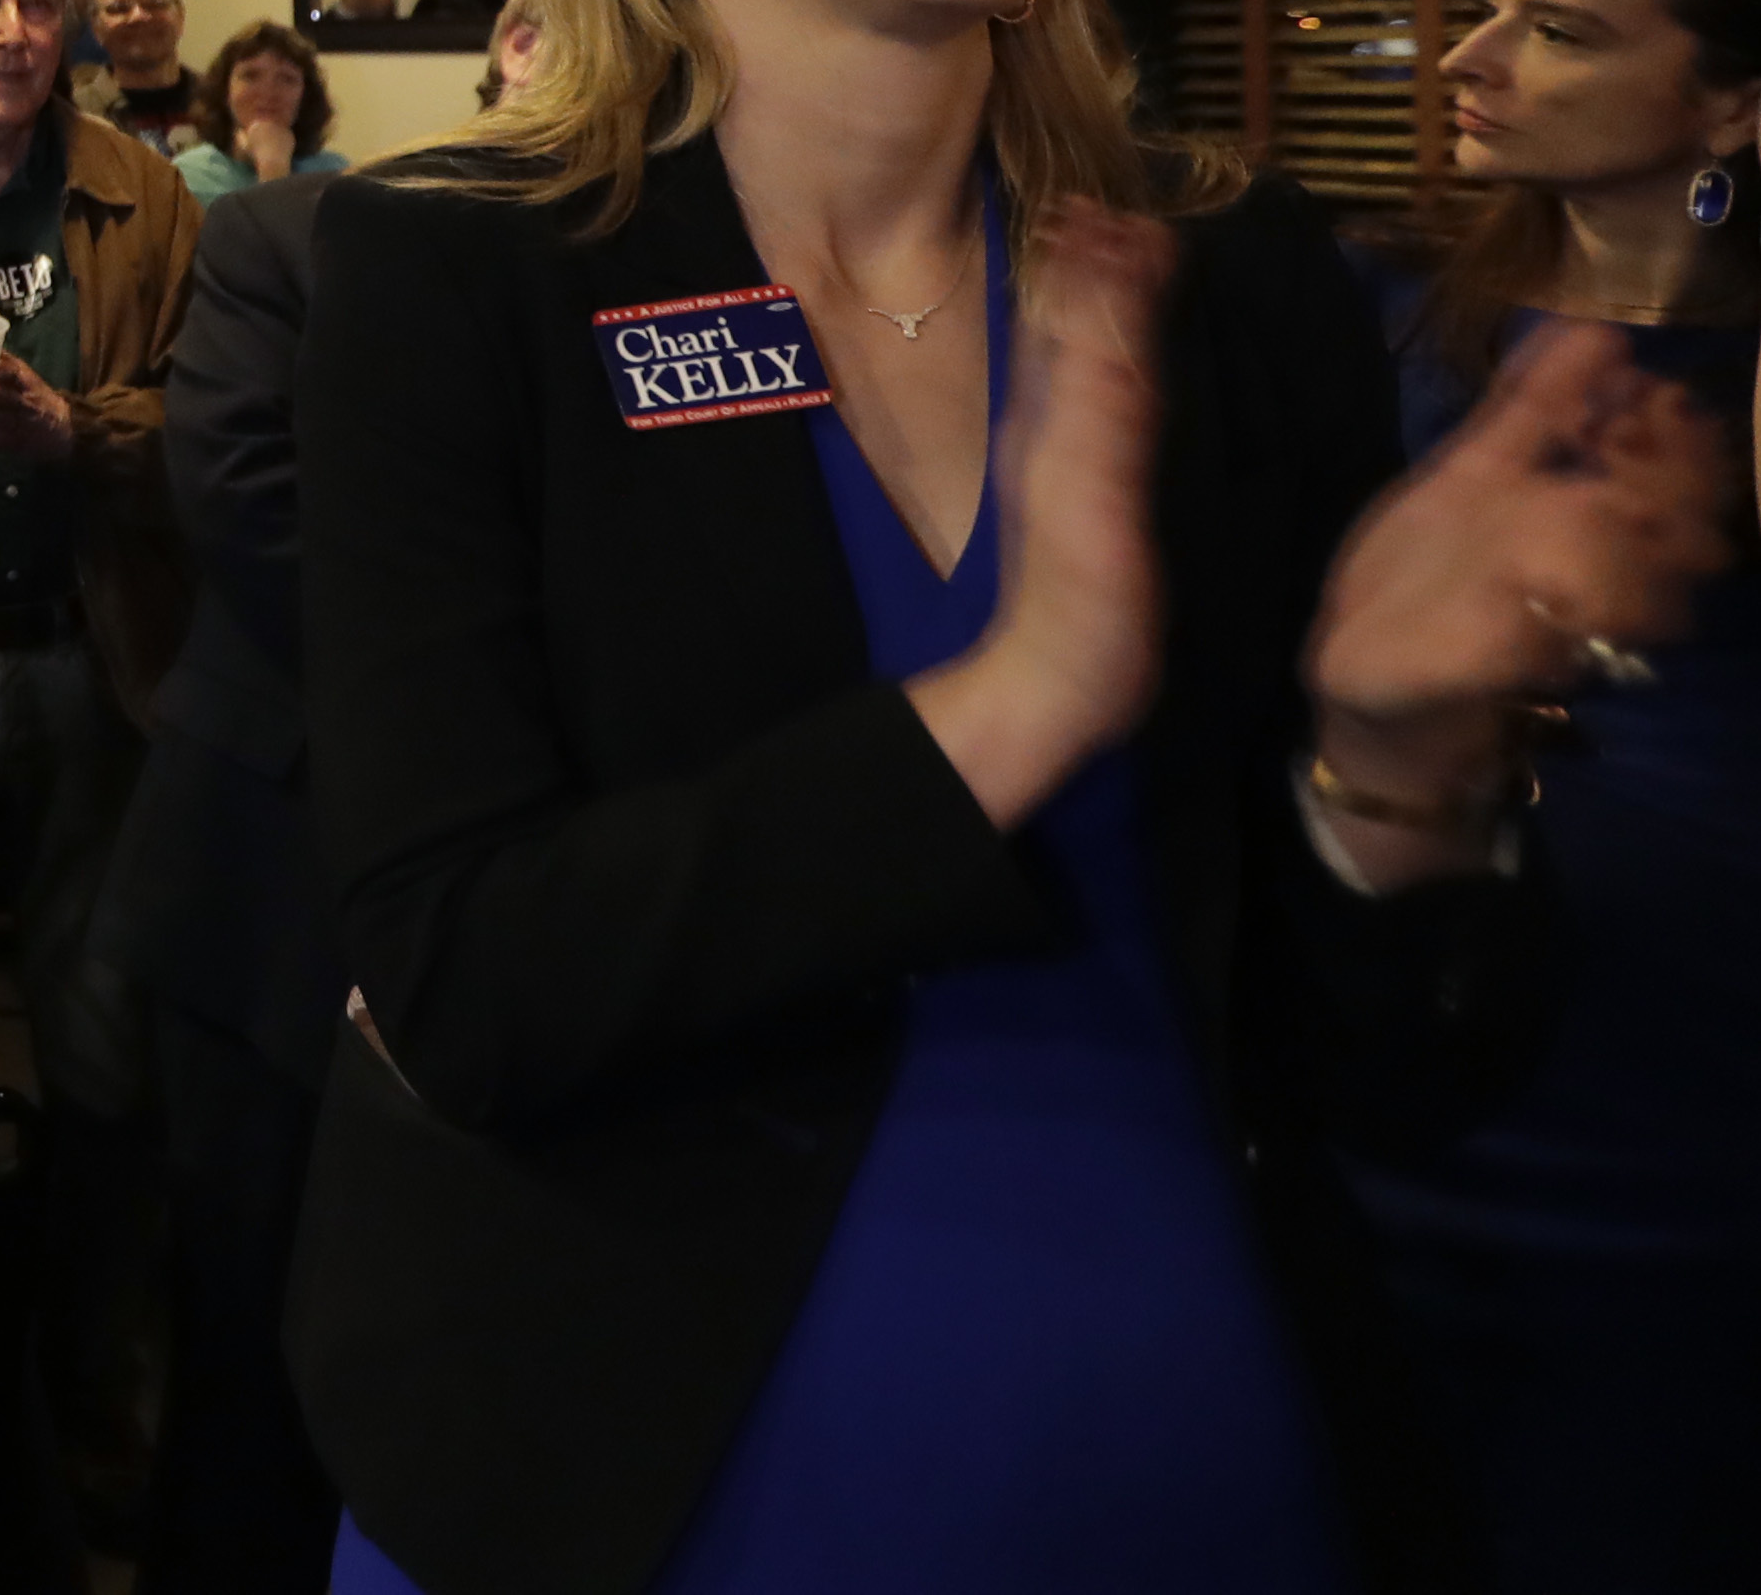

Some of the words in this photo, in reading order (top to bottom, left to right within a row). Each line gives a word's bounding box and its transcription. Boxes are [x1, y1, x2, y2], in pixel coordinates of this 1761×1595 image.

[639, 307, 650, 316] A
[615, 316, 739, 363] Chari
[623, 343, 806, 408] KELLY
